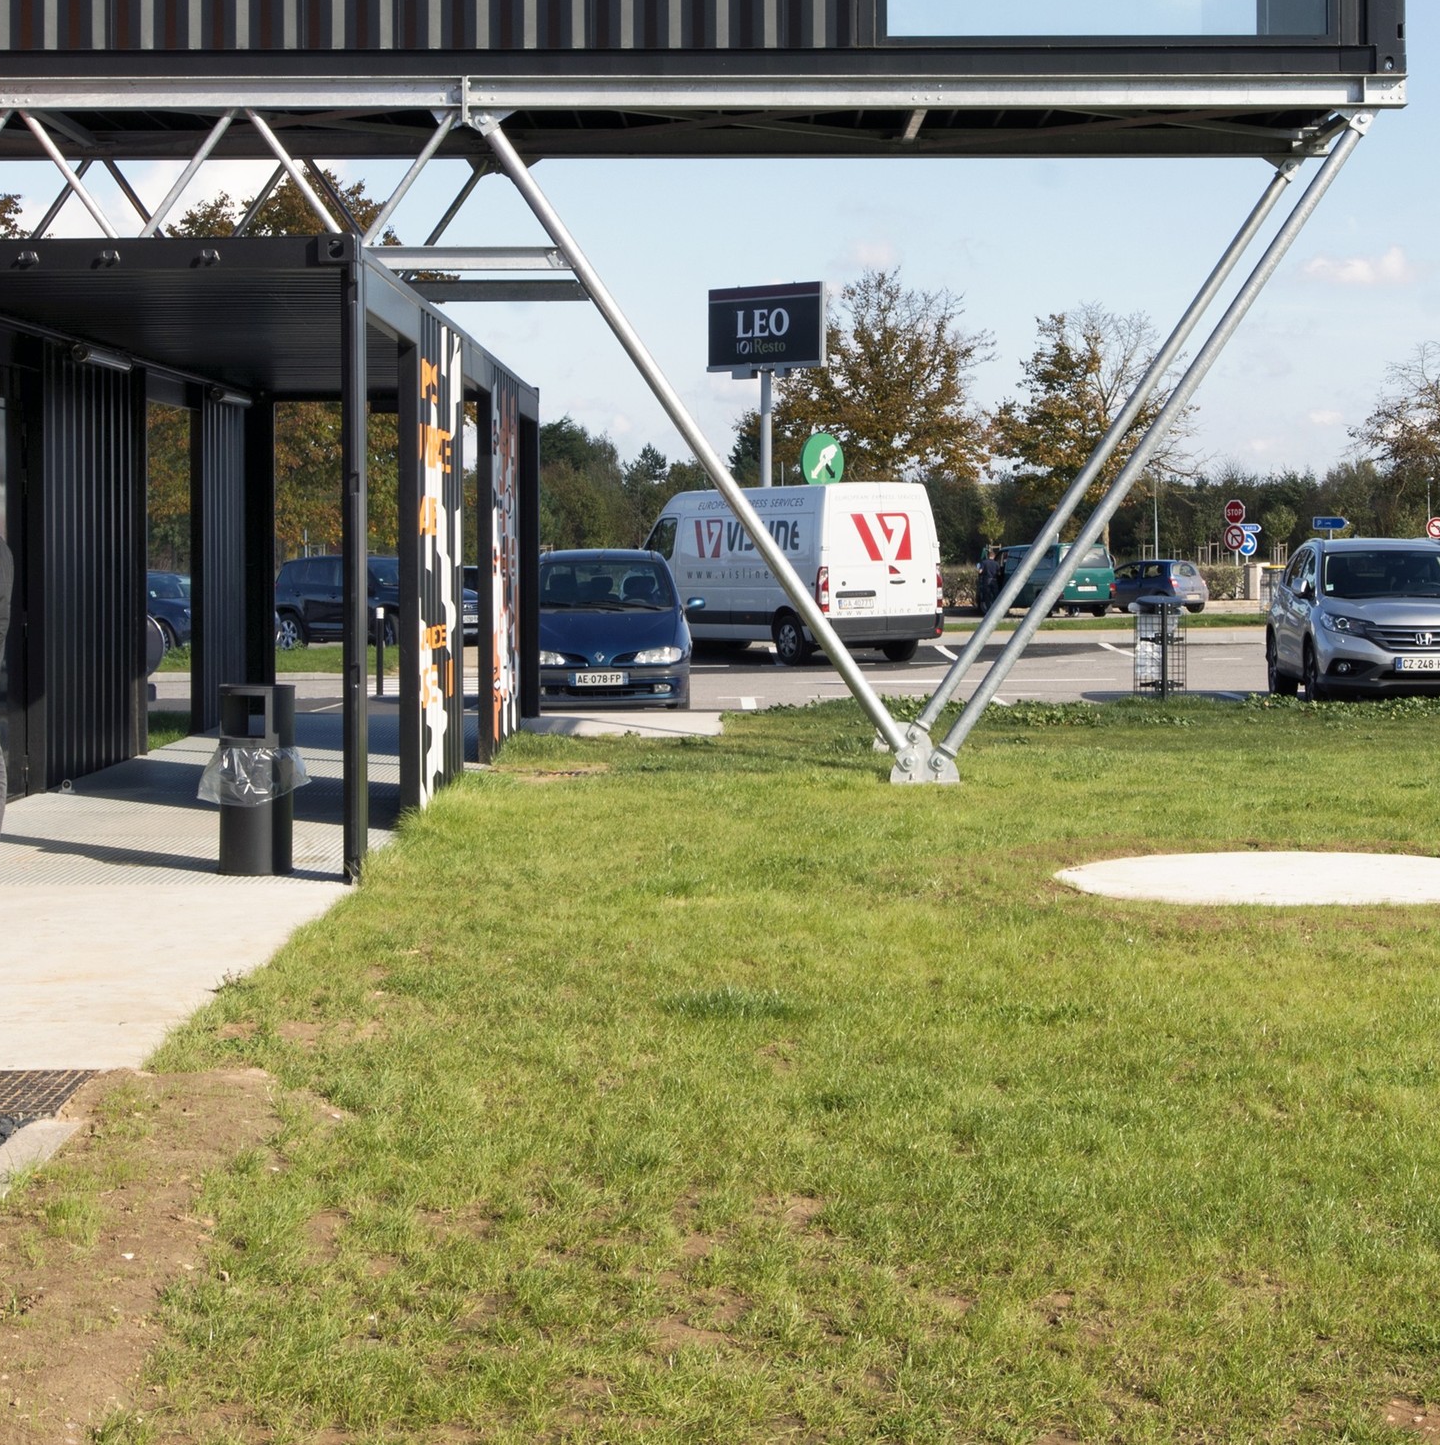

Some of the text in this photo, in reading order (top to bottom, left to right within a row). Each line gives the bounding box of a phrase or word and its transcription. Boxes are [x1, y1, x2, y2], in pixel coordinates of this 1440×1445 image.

[736, 307, 790, 338] LEO
[754, 338, 786, 354] Resto
[698, 500, 730, 511] EUROPE
[770, 497, 805, 508] SERVICES
[686, 568, 776, 580] www.visline.
[577, 674, 621, 684] AE-078-FP
